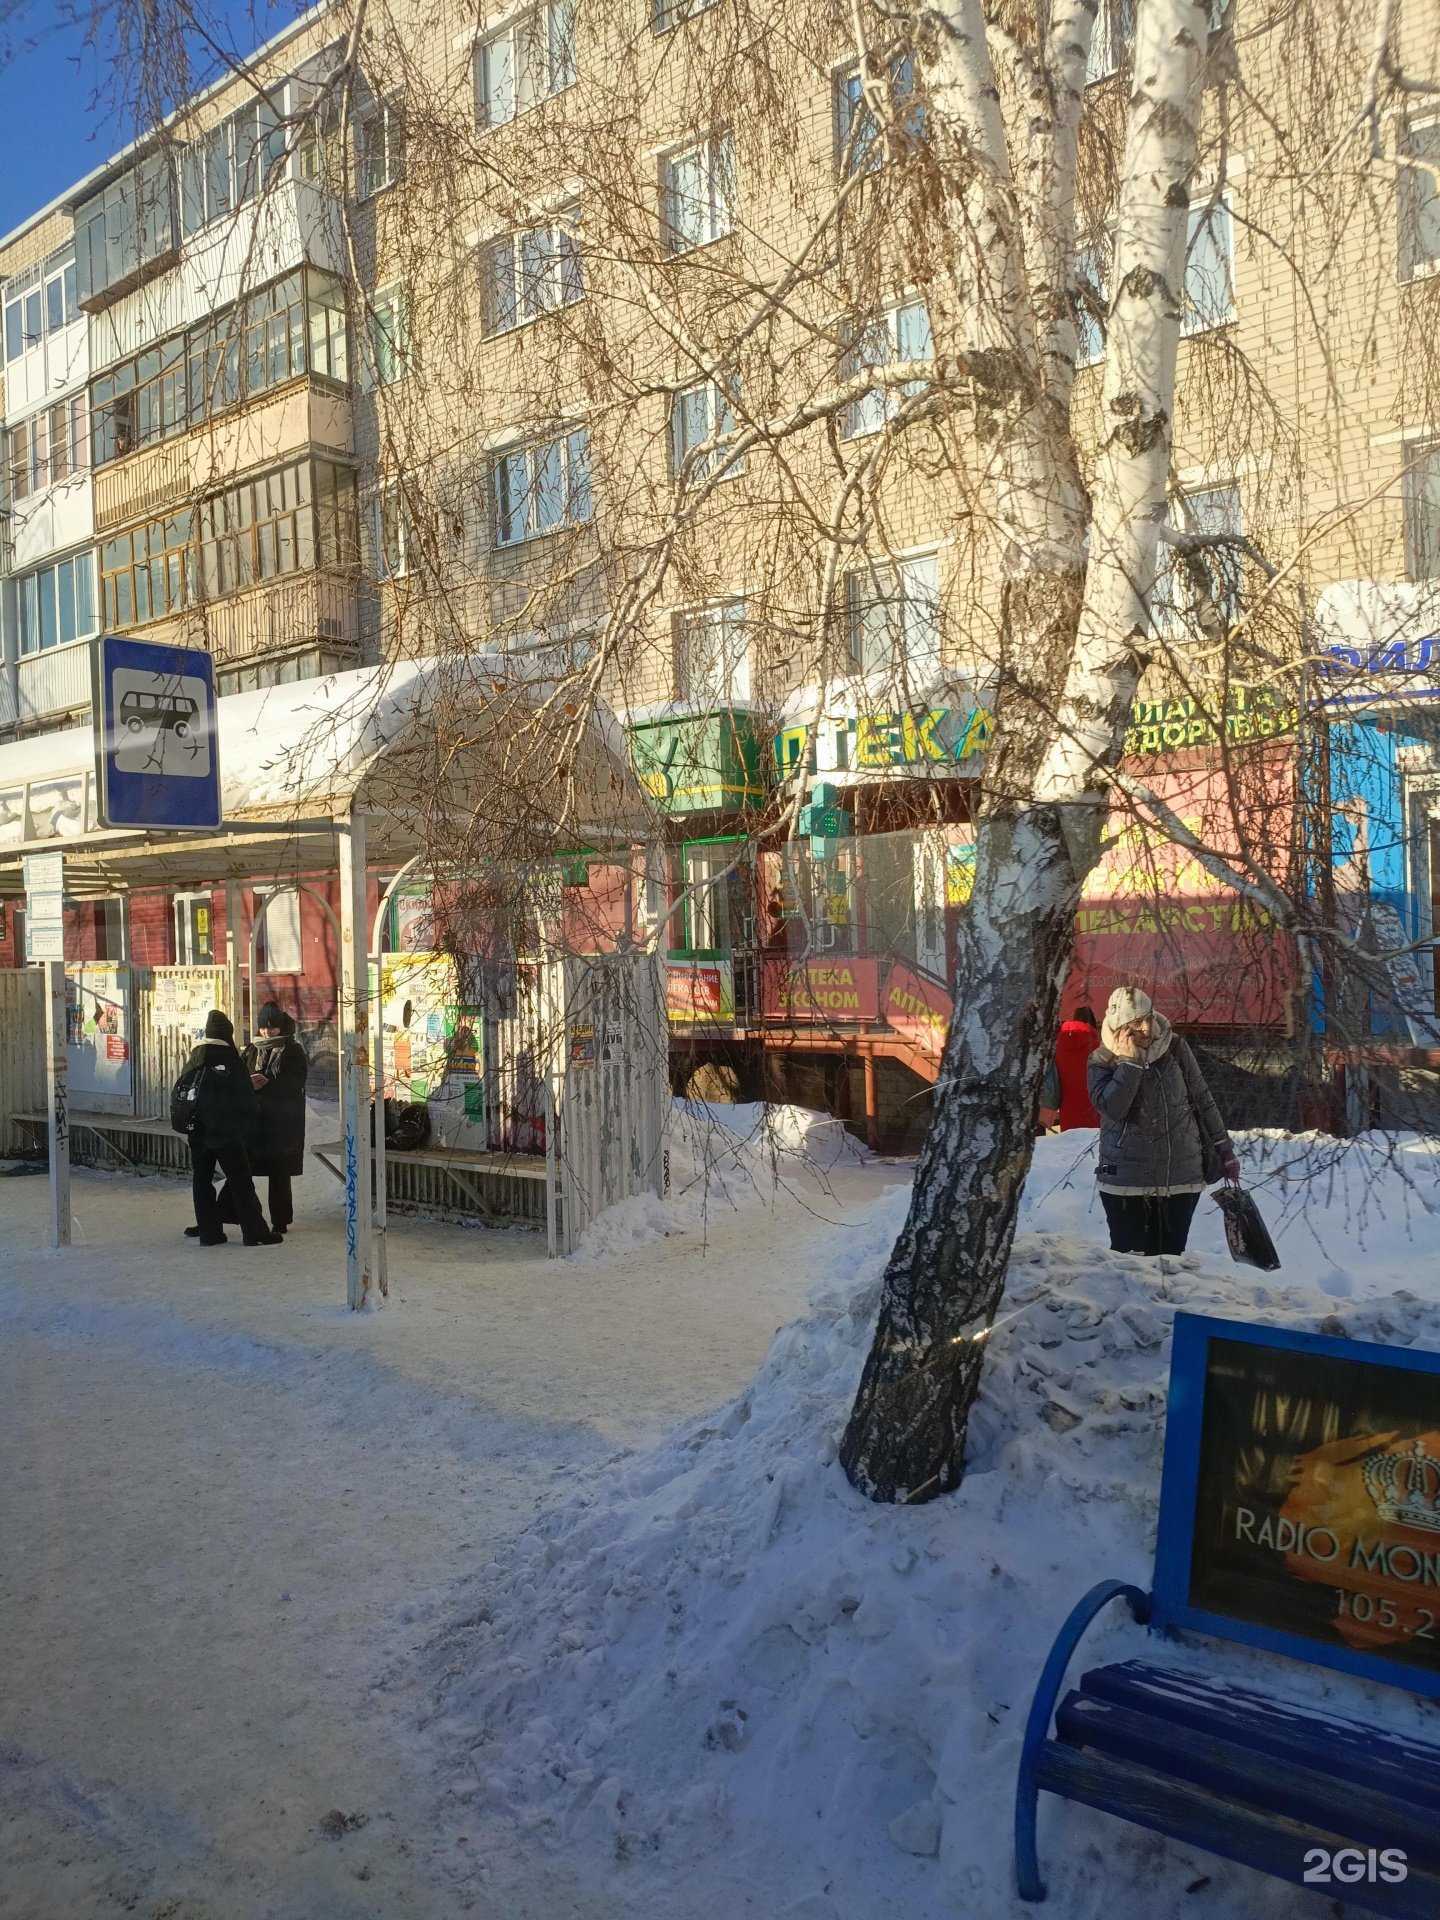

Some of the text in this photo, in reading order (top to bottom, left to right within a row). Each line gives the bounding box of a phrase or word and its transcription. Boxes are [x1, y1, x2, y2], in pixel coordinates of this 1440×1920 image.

[1235, 1507, 1440, 1587] RADIO MON
[1335, 1588, 1435, 1639] 105.2
